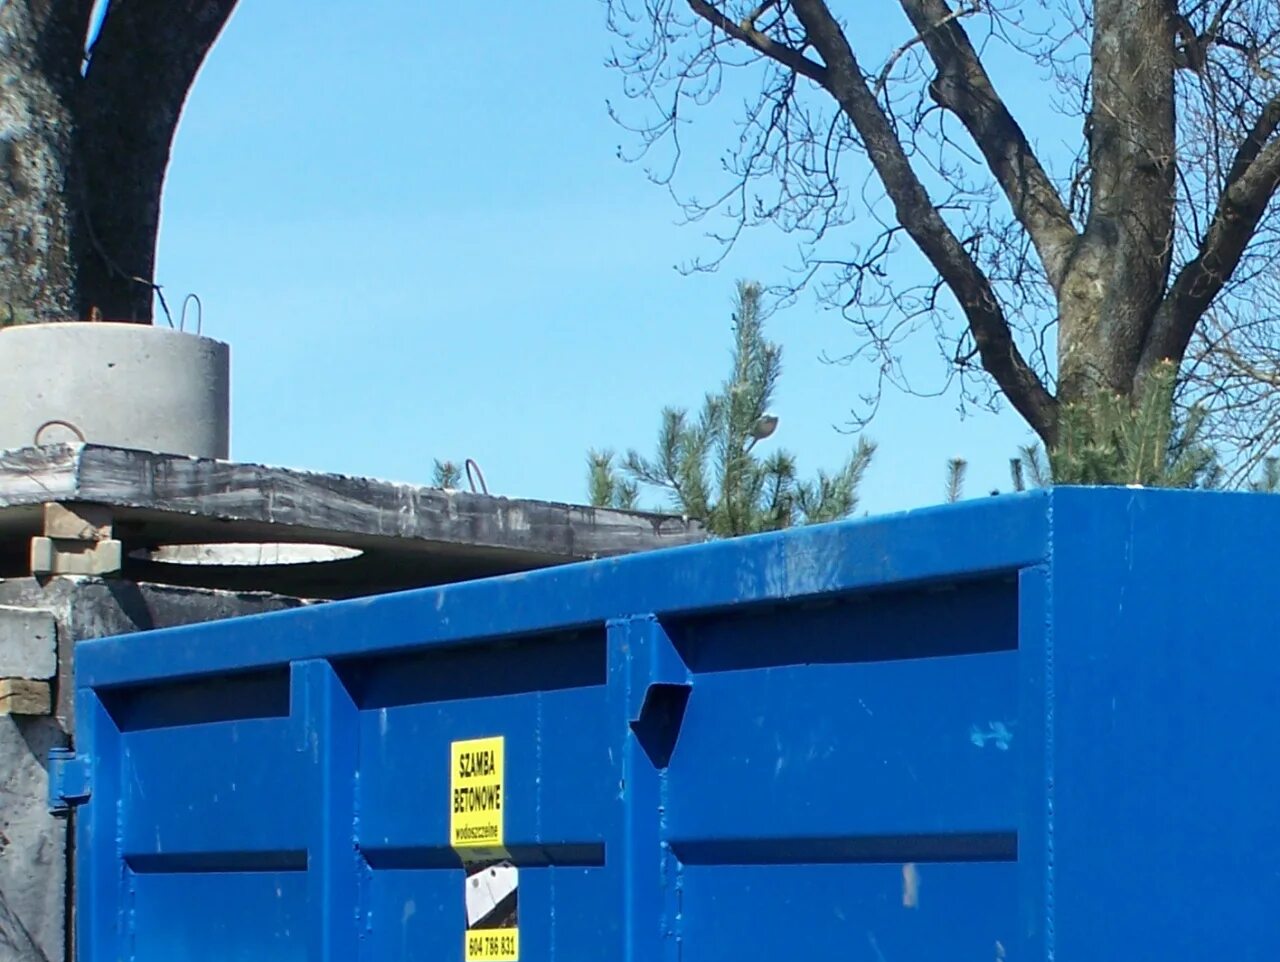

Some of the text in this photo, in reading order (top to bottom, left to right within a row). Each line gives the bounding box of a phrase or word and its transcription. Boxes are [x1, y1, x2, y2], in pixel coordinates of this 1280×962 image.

[459, 749, 496, 778] SZAMBA
[454, 784, 501, 813] BETONOWE
[469, 937, 483, 956] 604
